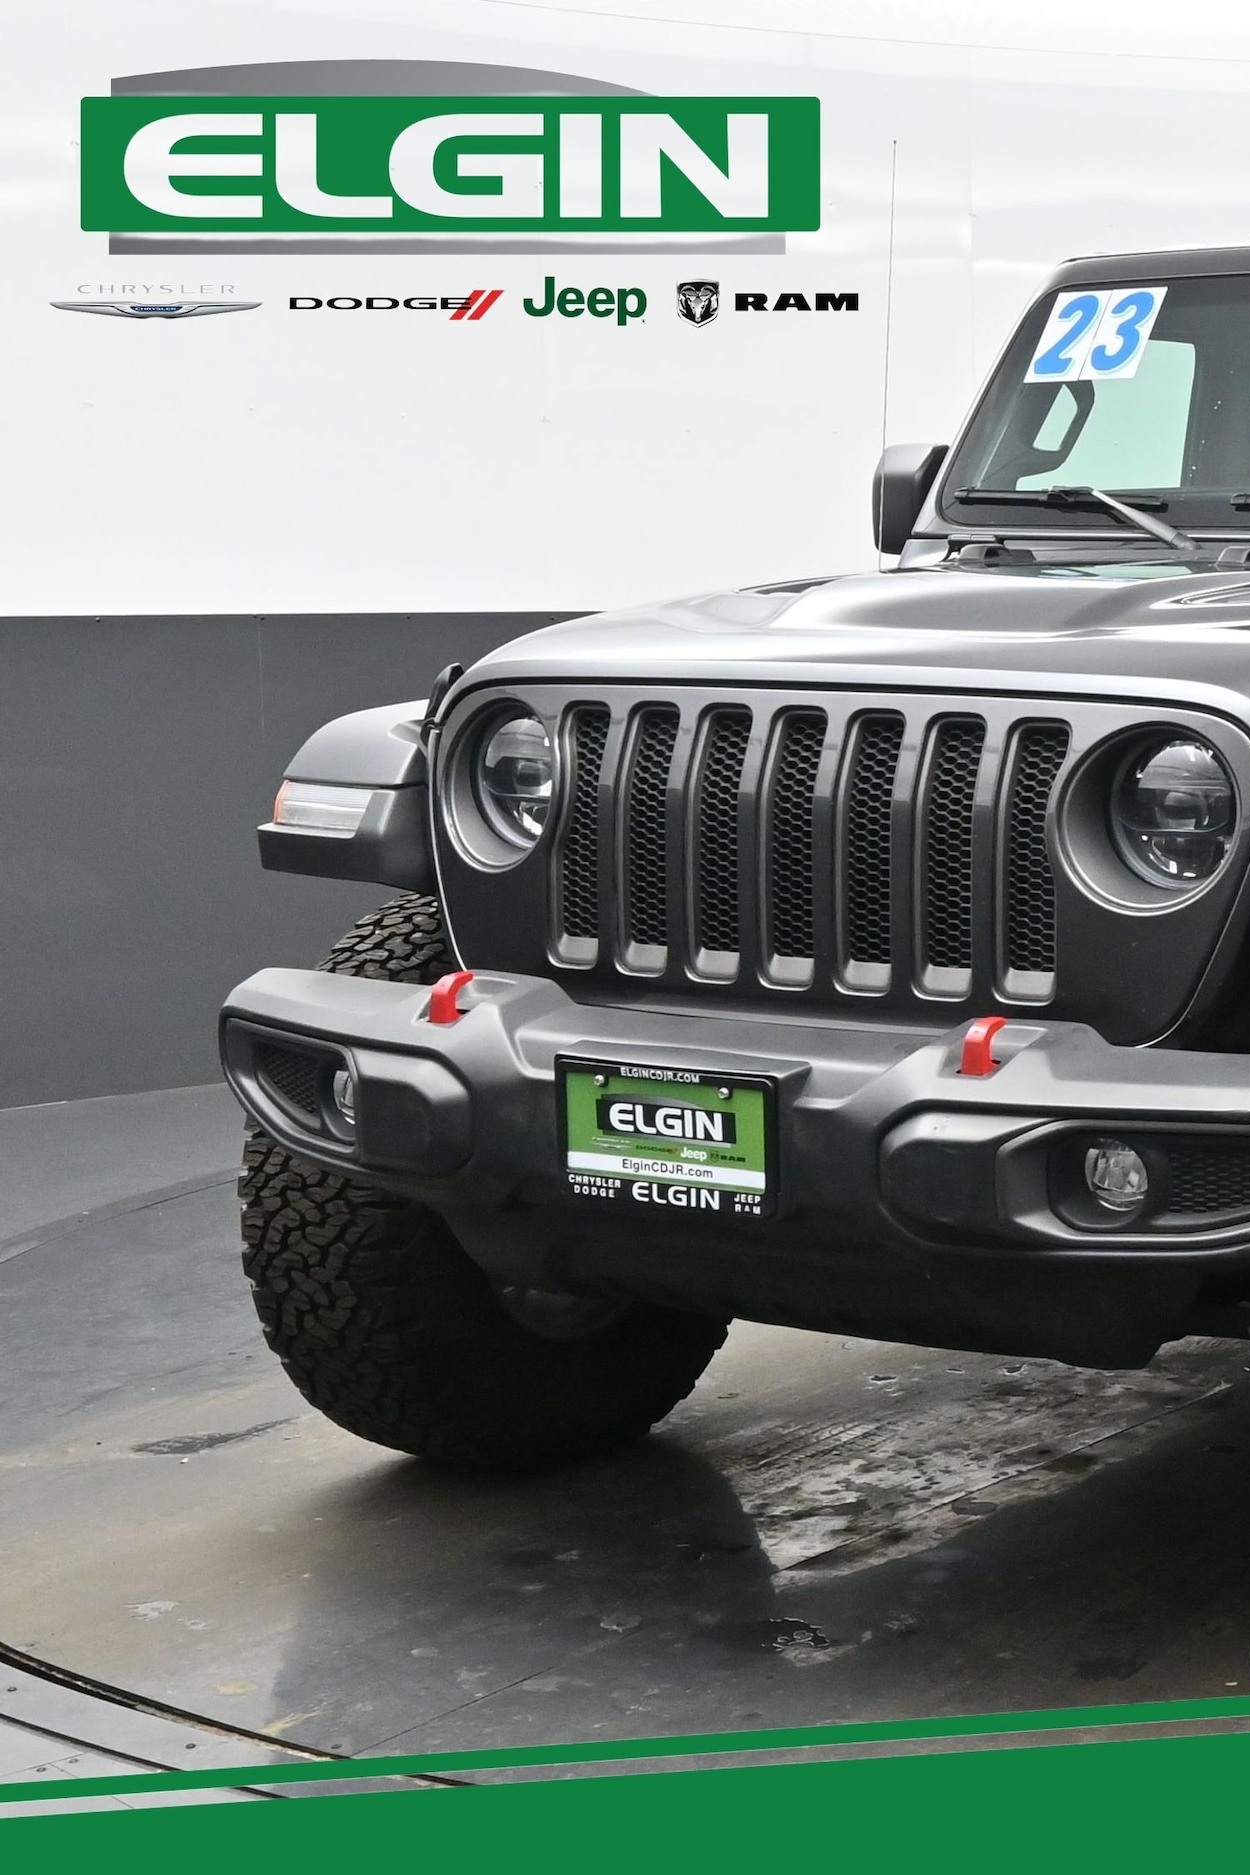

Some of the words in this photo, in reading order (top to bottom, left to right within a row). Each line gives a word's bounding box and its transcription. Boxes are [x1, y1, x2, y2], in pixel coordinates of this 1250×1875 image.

[1034, 292, 1154, 371] 23
[620, 1067, 700, 1083] ELGINCDJR.COM
[609, 1102, 723, 1141] ELGIN
[680, 1147, 708, 1161] Jeep
[622, 1159, 713, 1178] ElginCDJR.com
[568, 1174, 621, 1188] CHRYSLER
[574, 1185, 616, 1198] DODGE
[632, 1182, 720, 1210] ELGIN
[734, 1194, 761, 1204] JEEP
[734, 1204, 761, 1215] RAM
